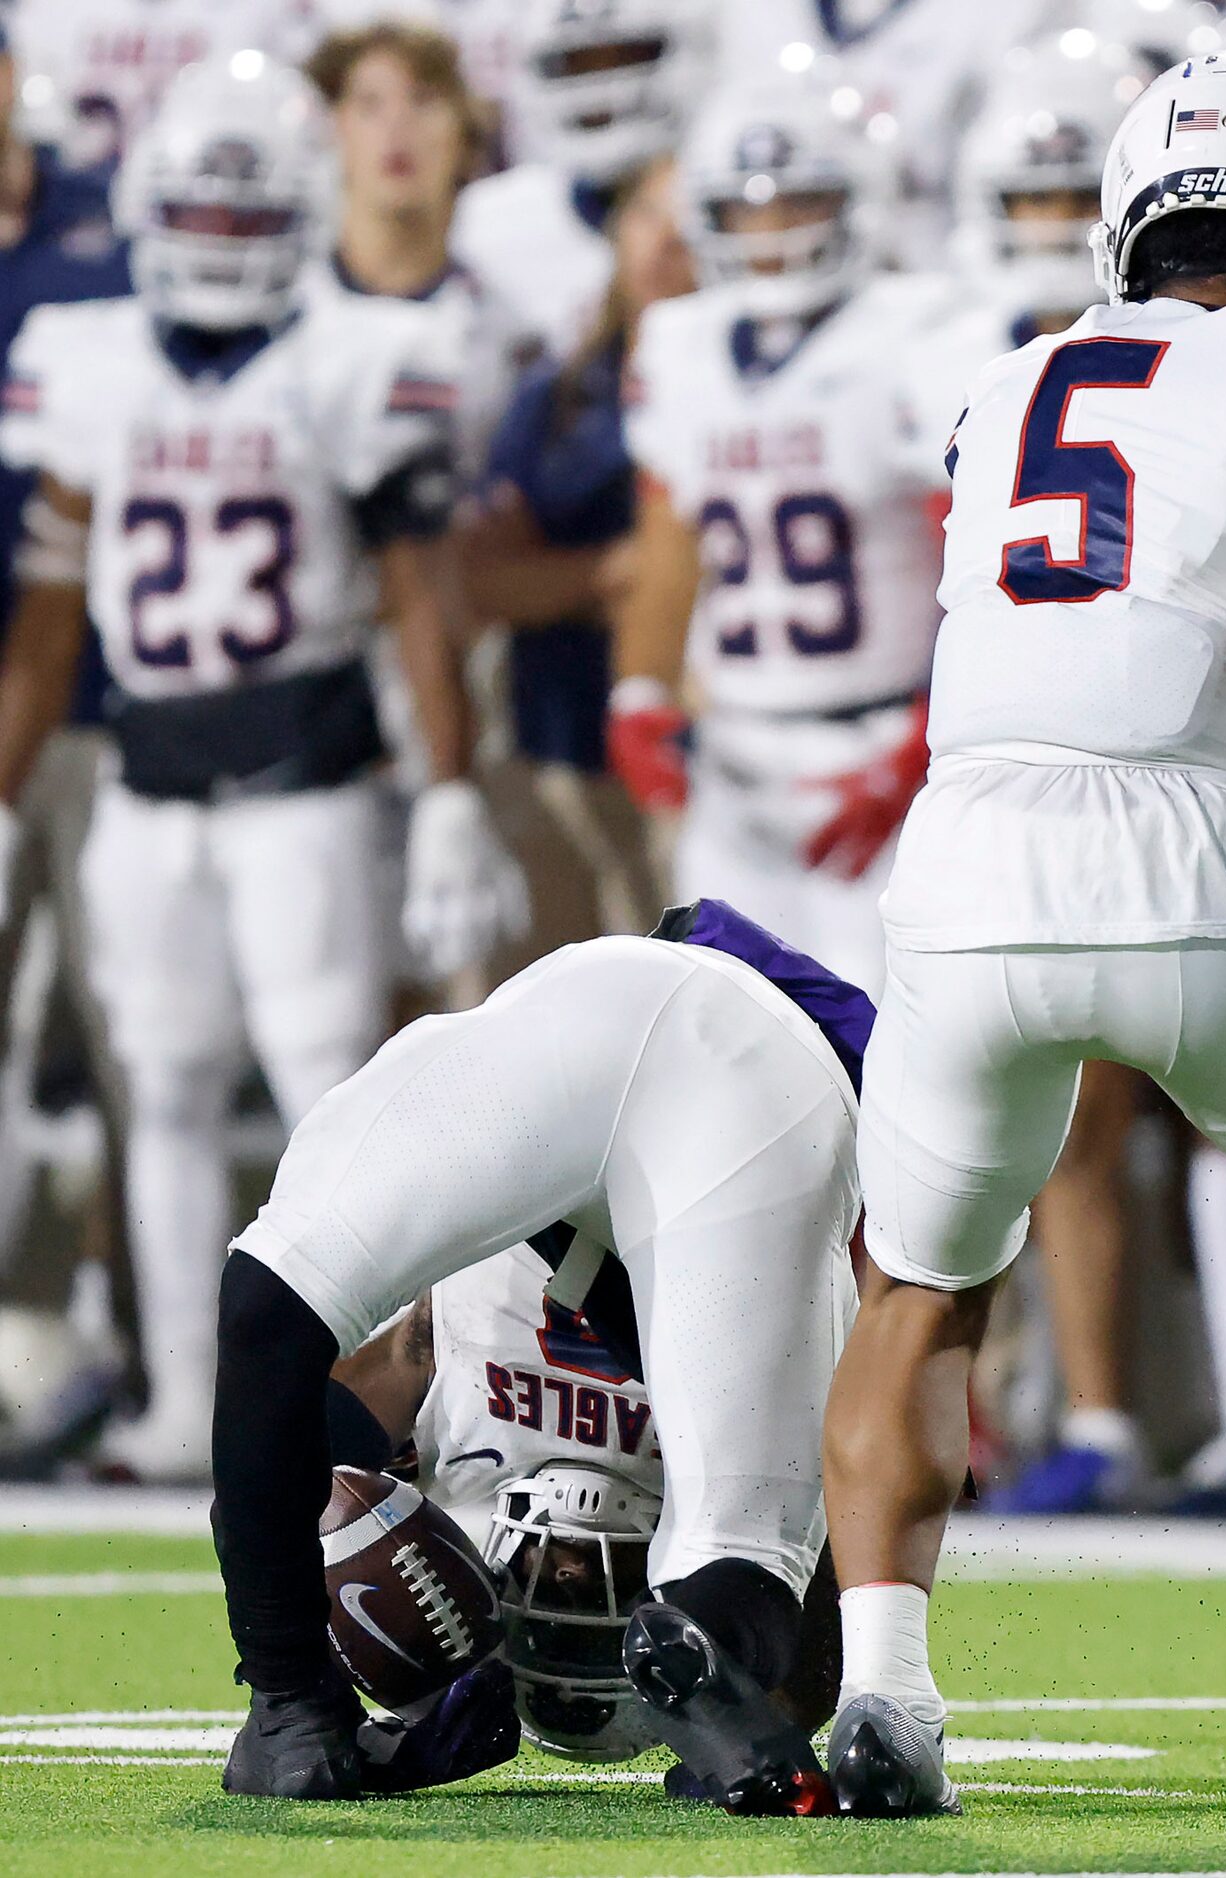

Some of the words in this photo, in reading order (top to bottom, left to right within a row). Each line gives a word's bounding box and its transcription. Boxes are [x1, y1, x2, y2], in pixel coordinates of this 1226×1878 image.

[997, 336, 1172, 606] 5
[123, 497, 296, 668] 23
[697, 494, 862, 657] 29
[486, 1361, 662, 1460] AGLES
